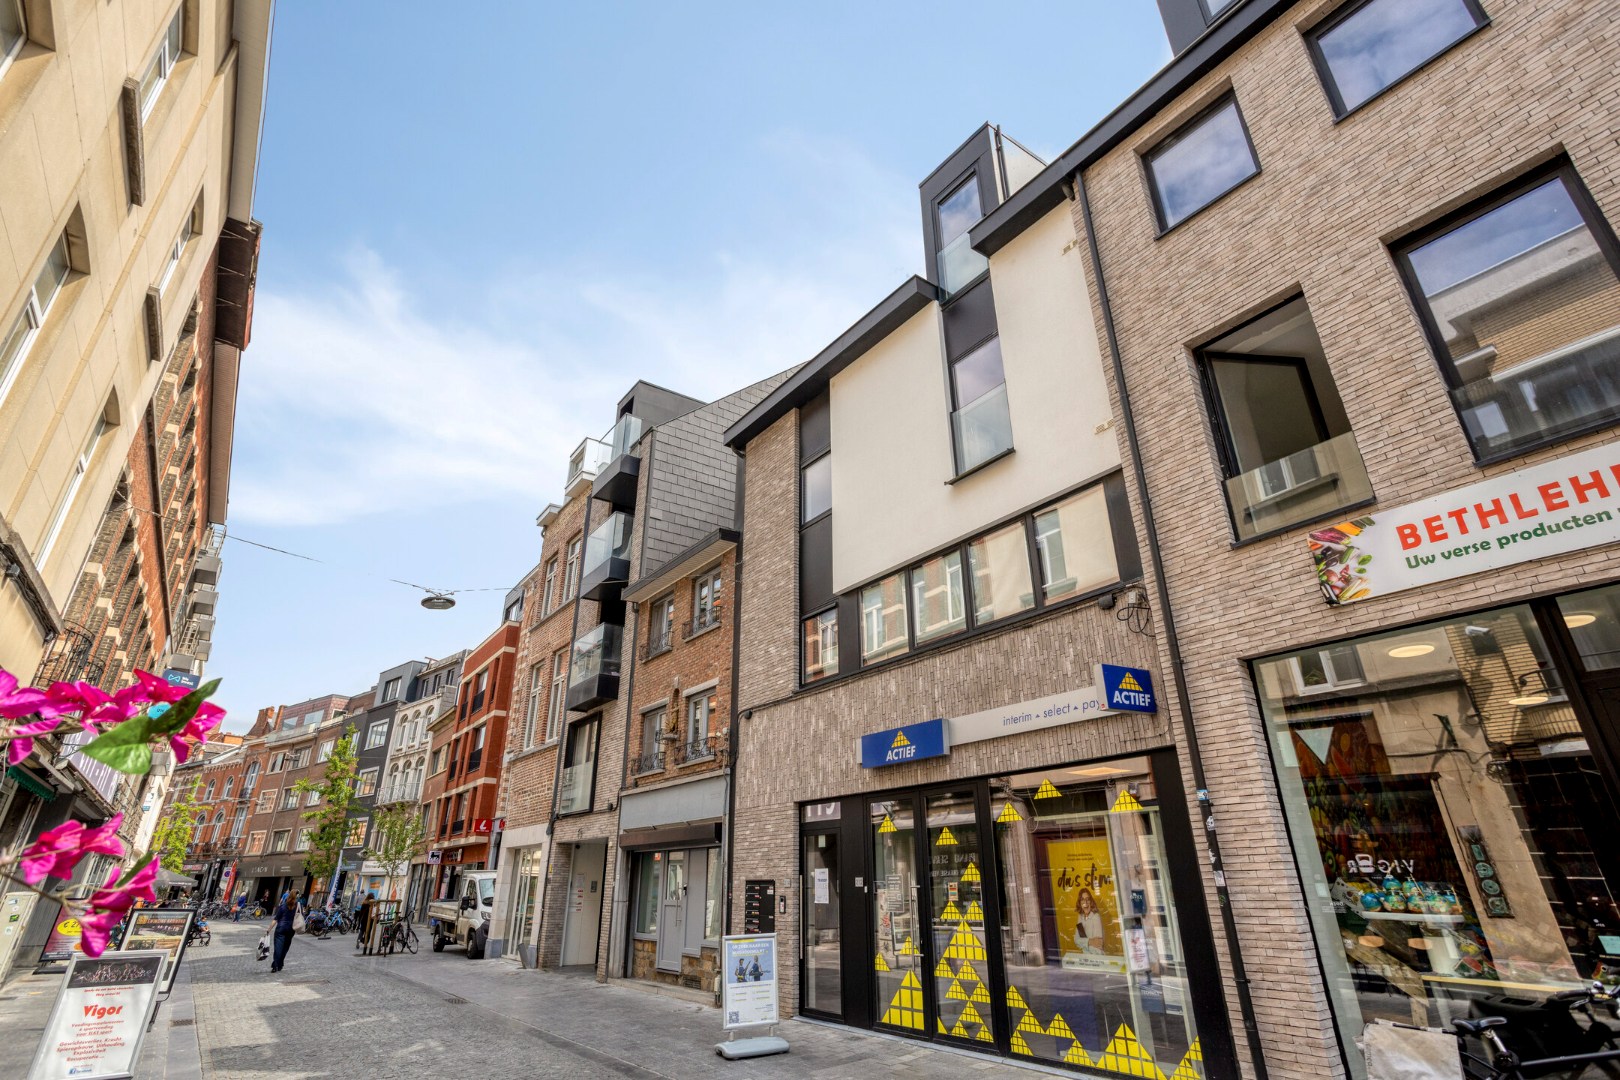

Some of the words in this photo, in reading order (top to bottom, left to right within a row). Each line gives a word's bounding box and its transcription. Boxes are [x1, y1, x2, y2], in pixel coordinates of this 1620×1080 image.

[1405, 553, 1436, 569] Uw
[1440, 538, 1492, 560] verse
[1496, 508, 1613, 549] producten
[1113, 690, 1151, 707] ACTIEF
[1002, 712, 1032, 727] interim
[1043, 704, 1071, 718] select
[886, 745, 916, 762] ACTIEF
[83, 1004, 123, 1019] Vigor
